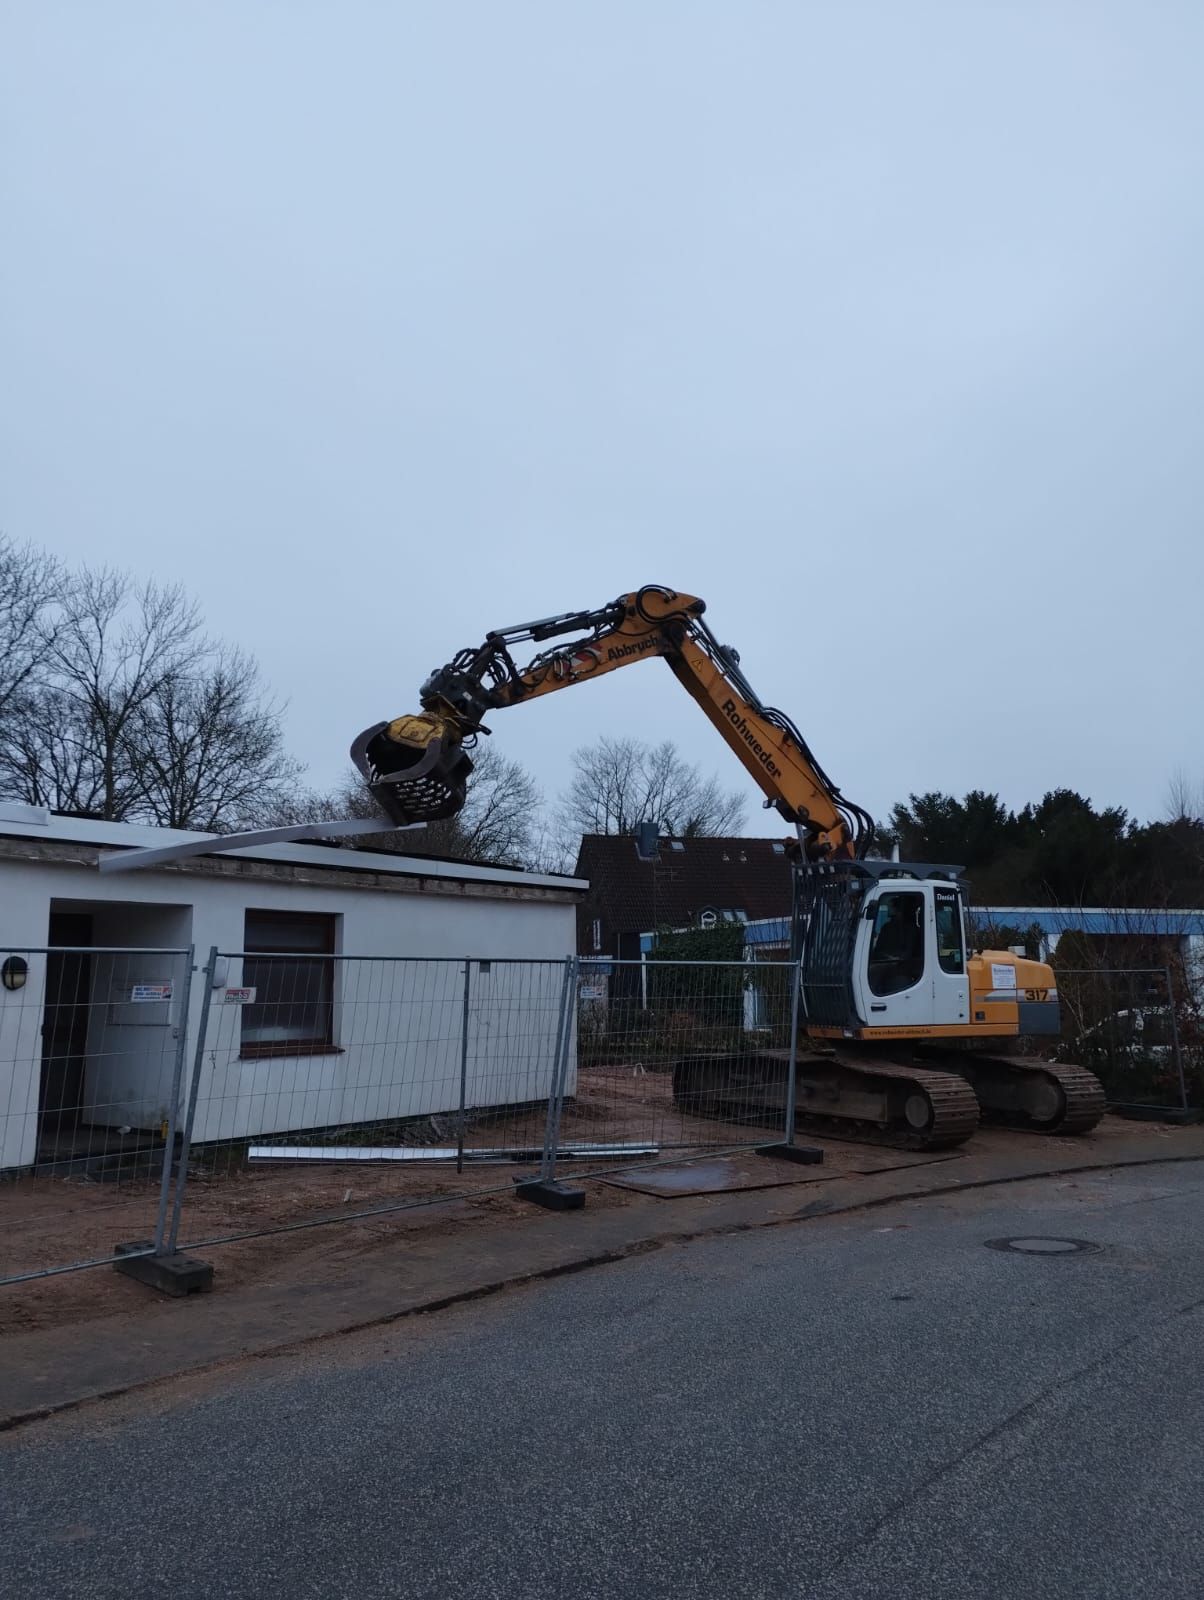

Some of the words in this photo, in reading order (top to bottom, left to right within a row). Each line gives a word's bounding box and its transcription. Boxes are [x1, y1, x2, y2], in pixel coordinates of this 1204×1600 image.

[608, 634, 658, 661] Abbruch
[721, 699, 782, 778] Rohweder
[1025, 989, 1048, 1001] 317
